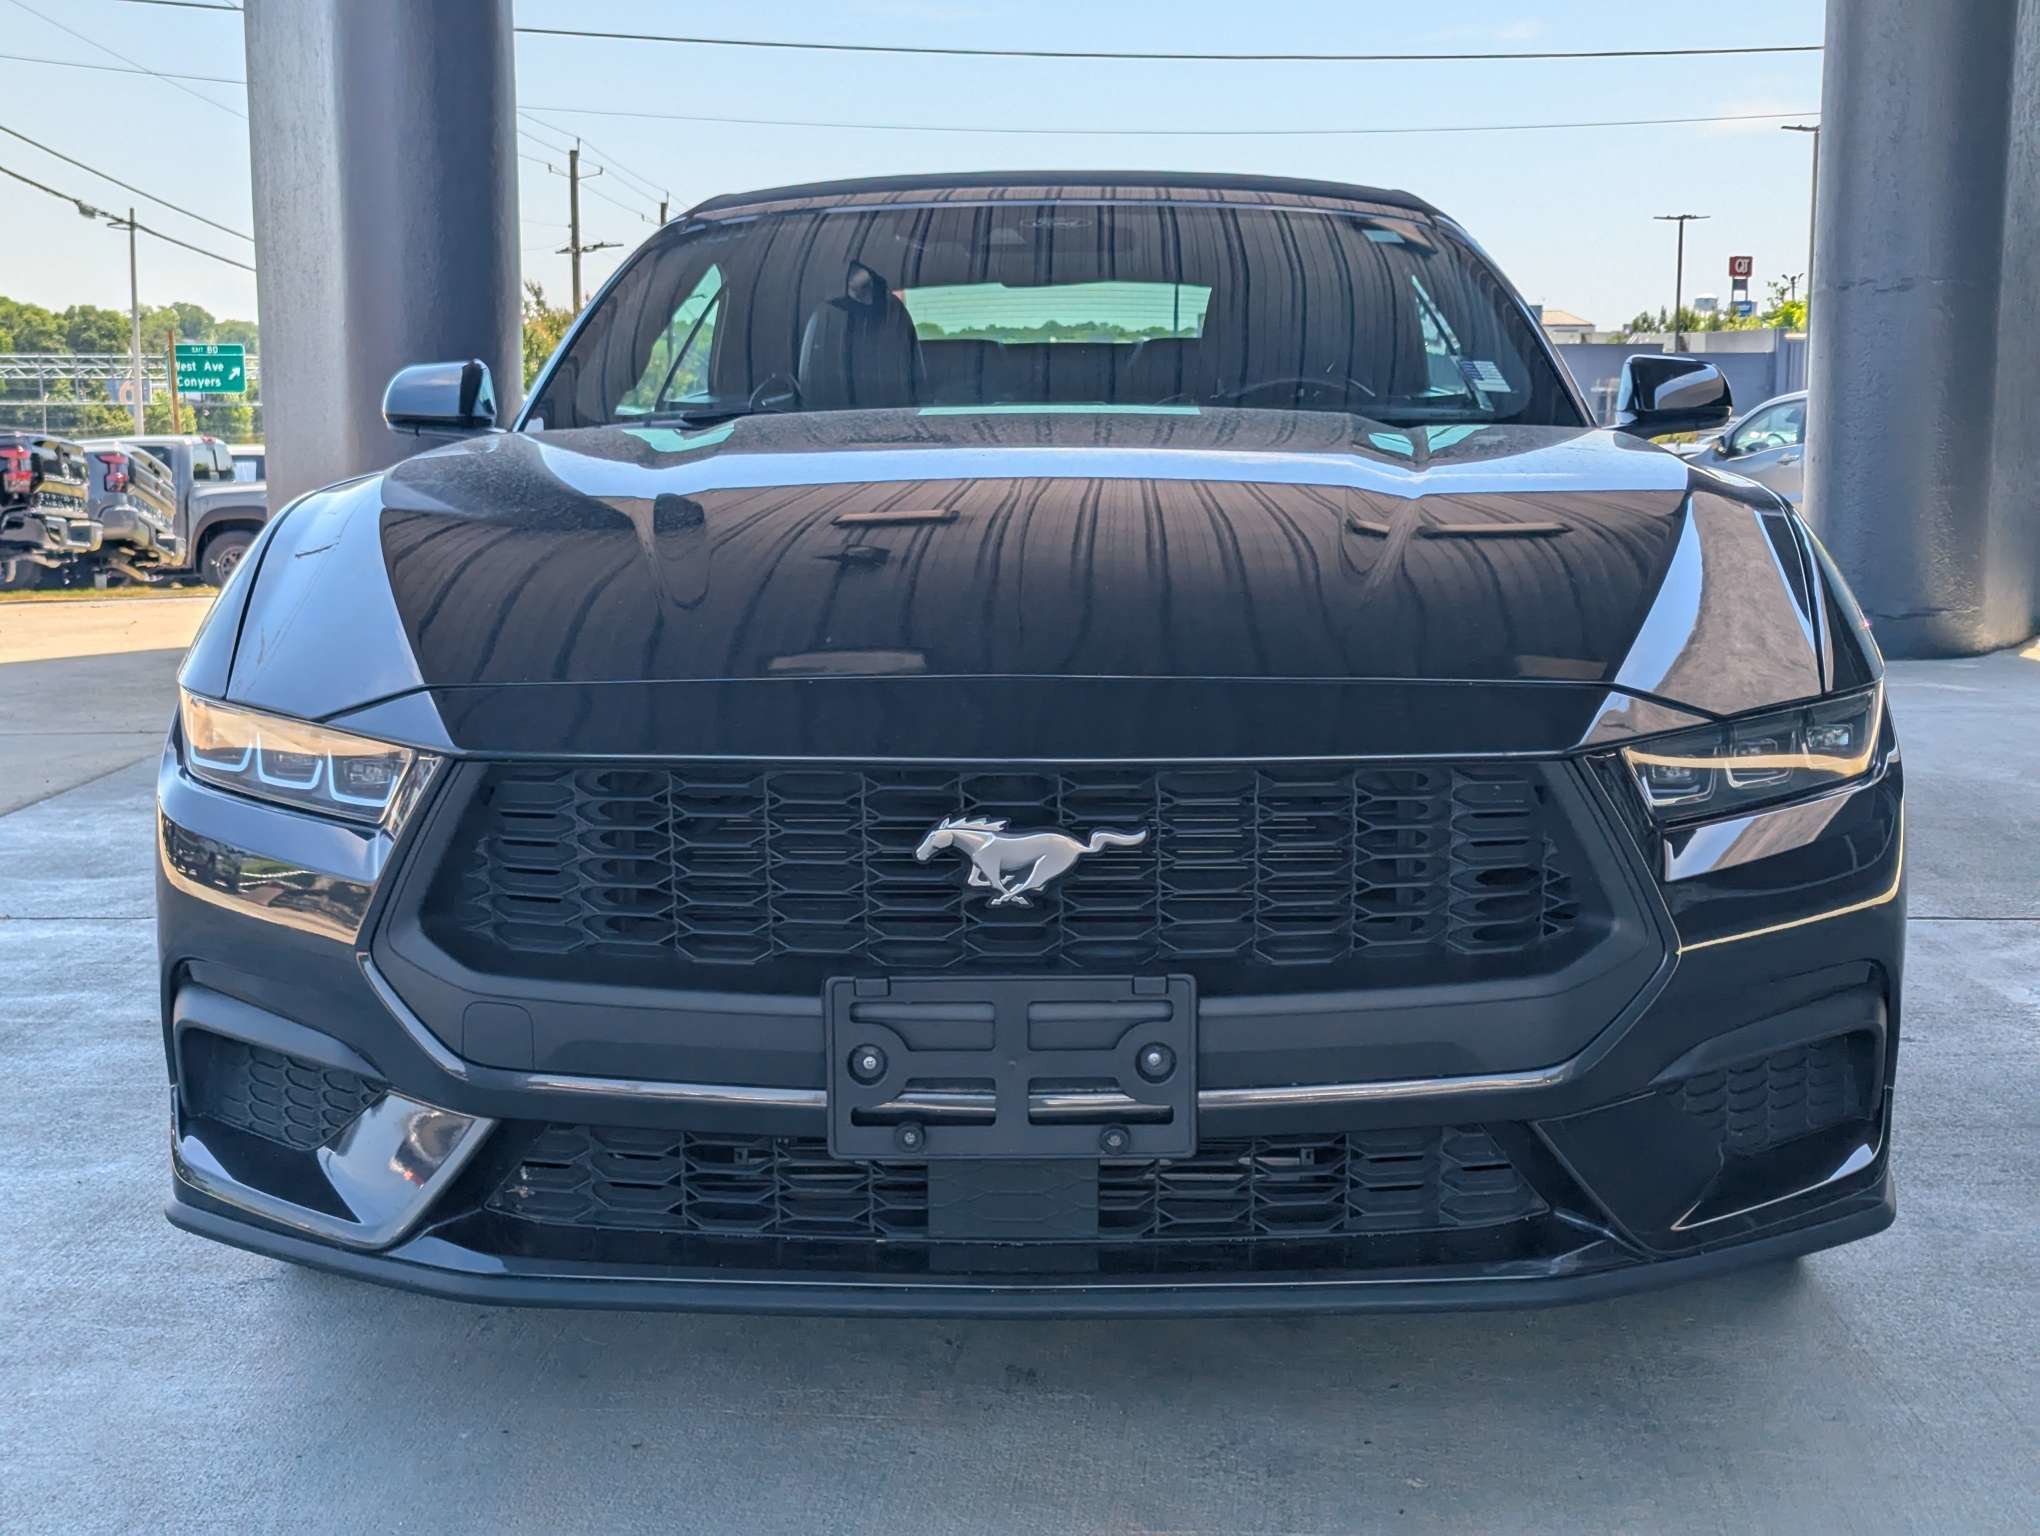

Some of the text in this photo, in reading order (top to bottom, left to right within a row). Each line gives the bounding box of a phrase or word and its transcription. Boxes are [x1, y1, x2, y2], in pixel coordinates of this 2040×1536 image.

[1735, 258, 1750, 273] QT
[203, 361, 225, 372] Ave
[177, 376, 222, 389] Conyers
